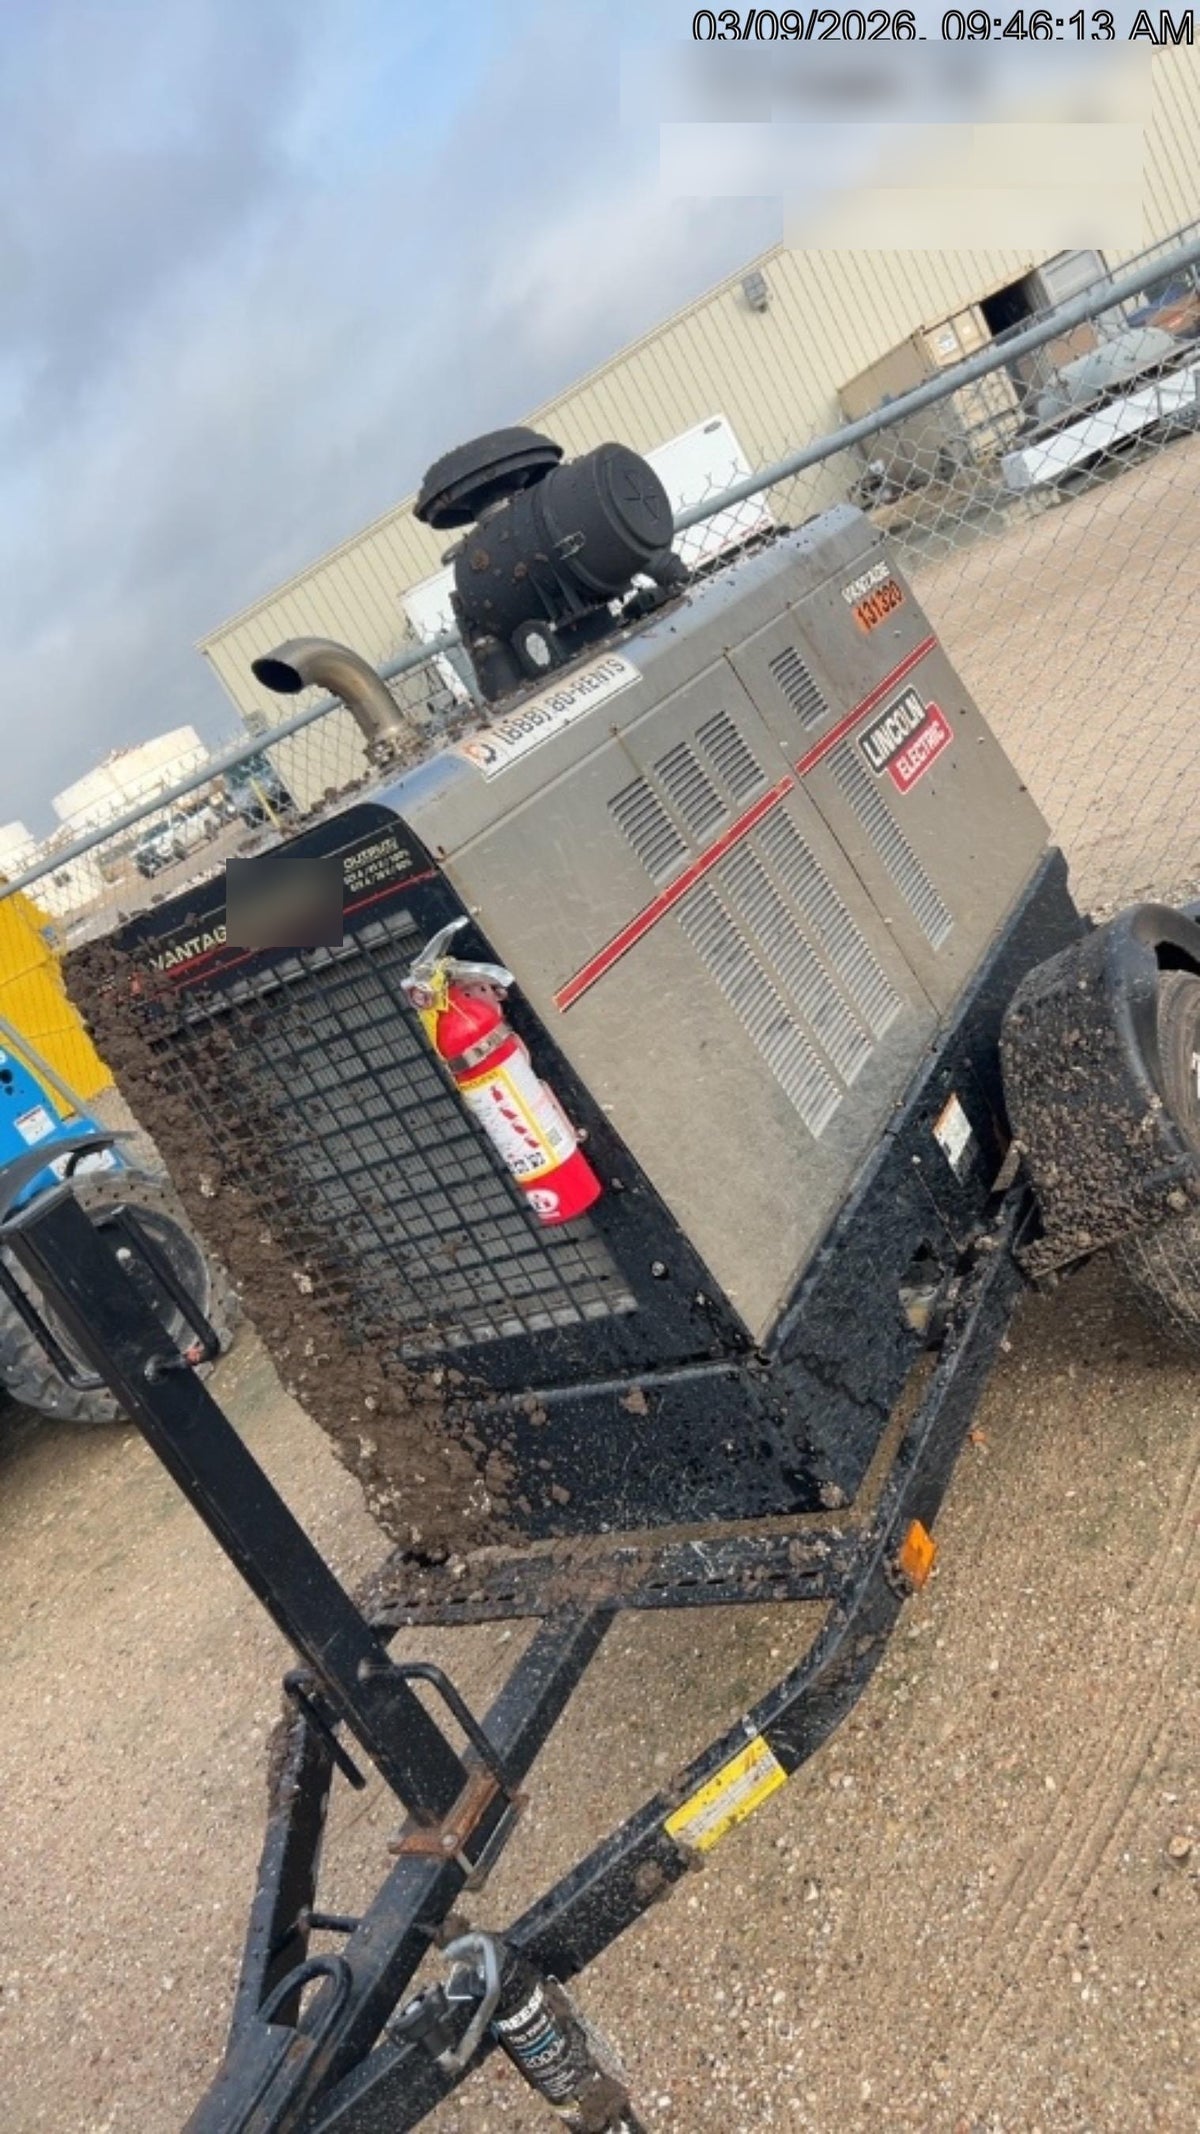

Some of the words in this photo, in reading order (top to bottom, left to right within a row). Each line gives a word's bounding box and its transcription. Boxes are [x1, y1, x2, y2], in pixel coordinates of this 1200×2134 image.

[493, 706, 553, 745] (888)
[862, 693, 926, 767] LINCOLN
[895, 719, 945, 781] ELECTRIC
[148, 924, 226, 971] VANTAG
